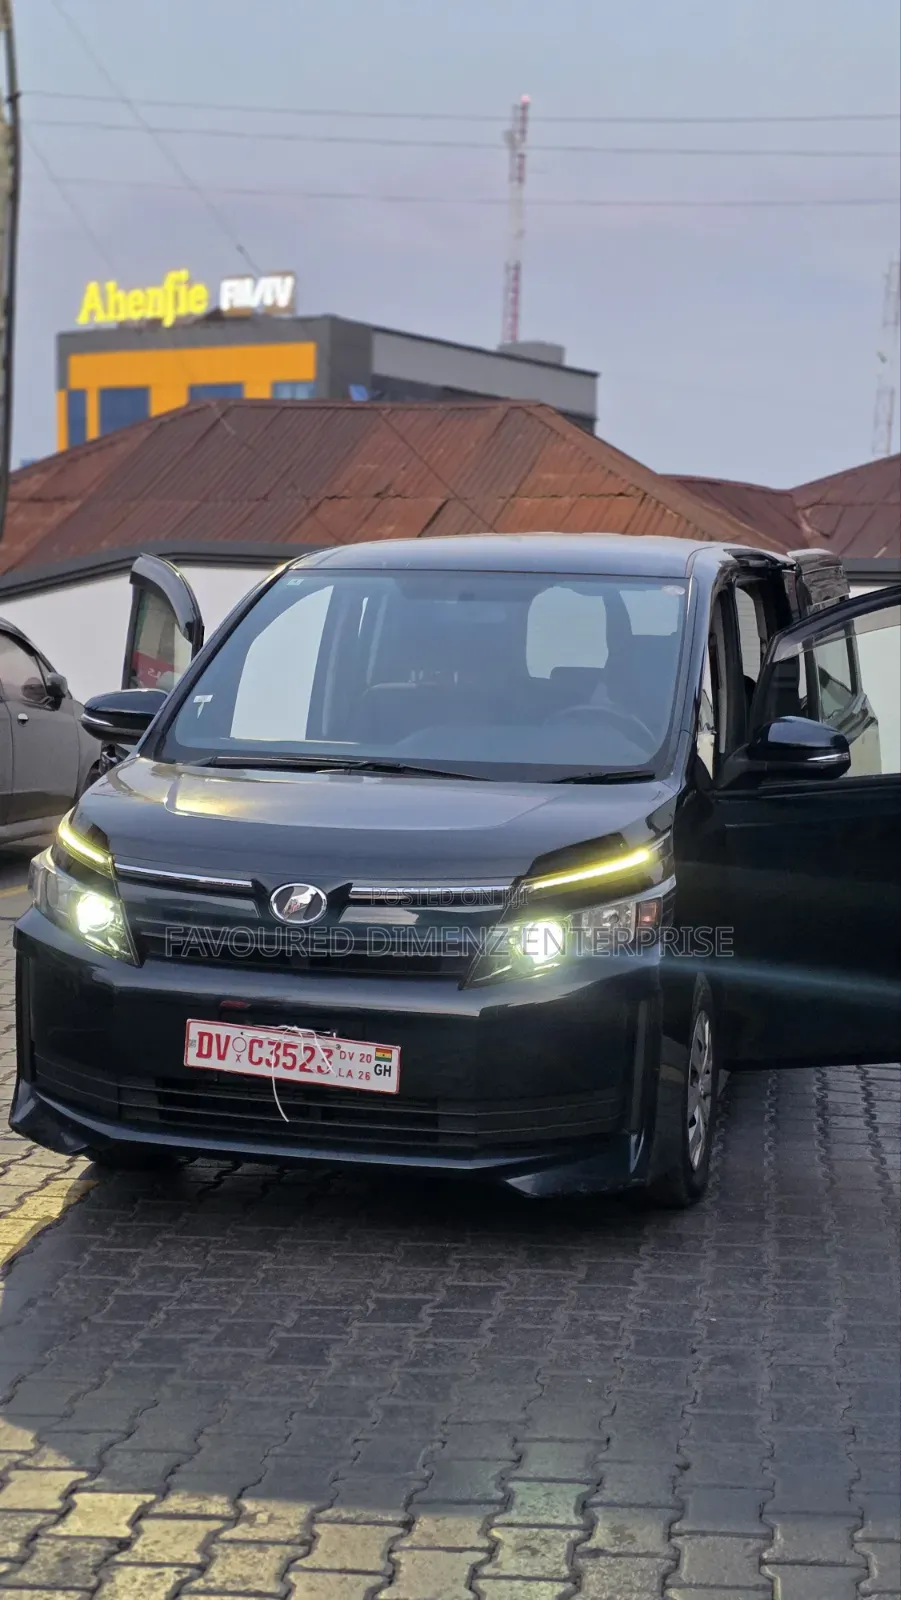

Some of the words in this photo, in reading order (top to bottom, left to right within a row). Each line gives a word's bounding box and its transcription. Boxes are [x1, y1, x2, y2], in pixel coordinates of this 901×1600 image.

[76, 268, 209, 328] Ahenfie
[196, 1031, 231, 1061] DV
[248, 1038, 334, 1075] C3523
[340, 1050, 355, 1061] DV
[359, 1053, 372, 1064] 20
[358, 1070, 371, 1081] 26
[373, 1063, 392, 1078] GH
